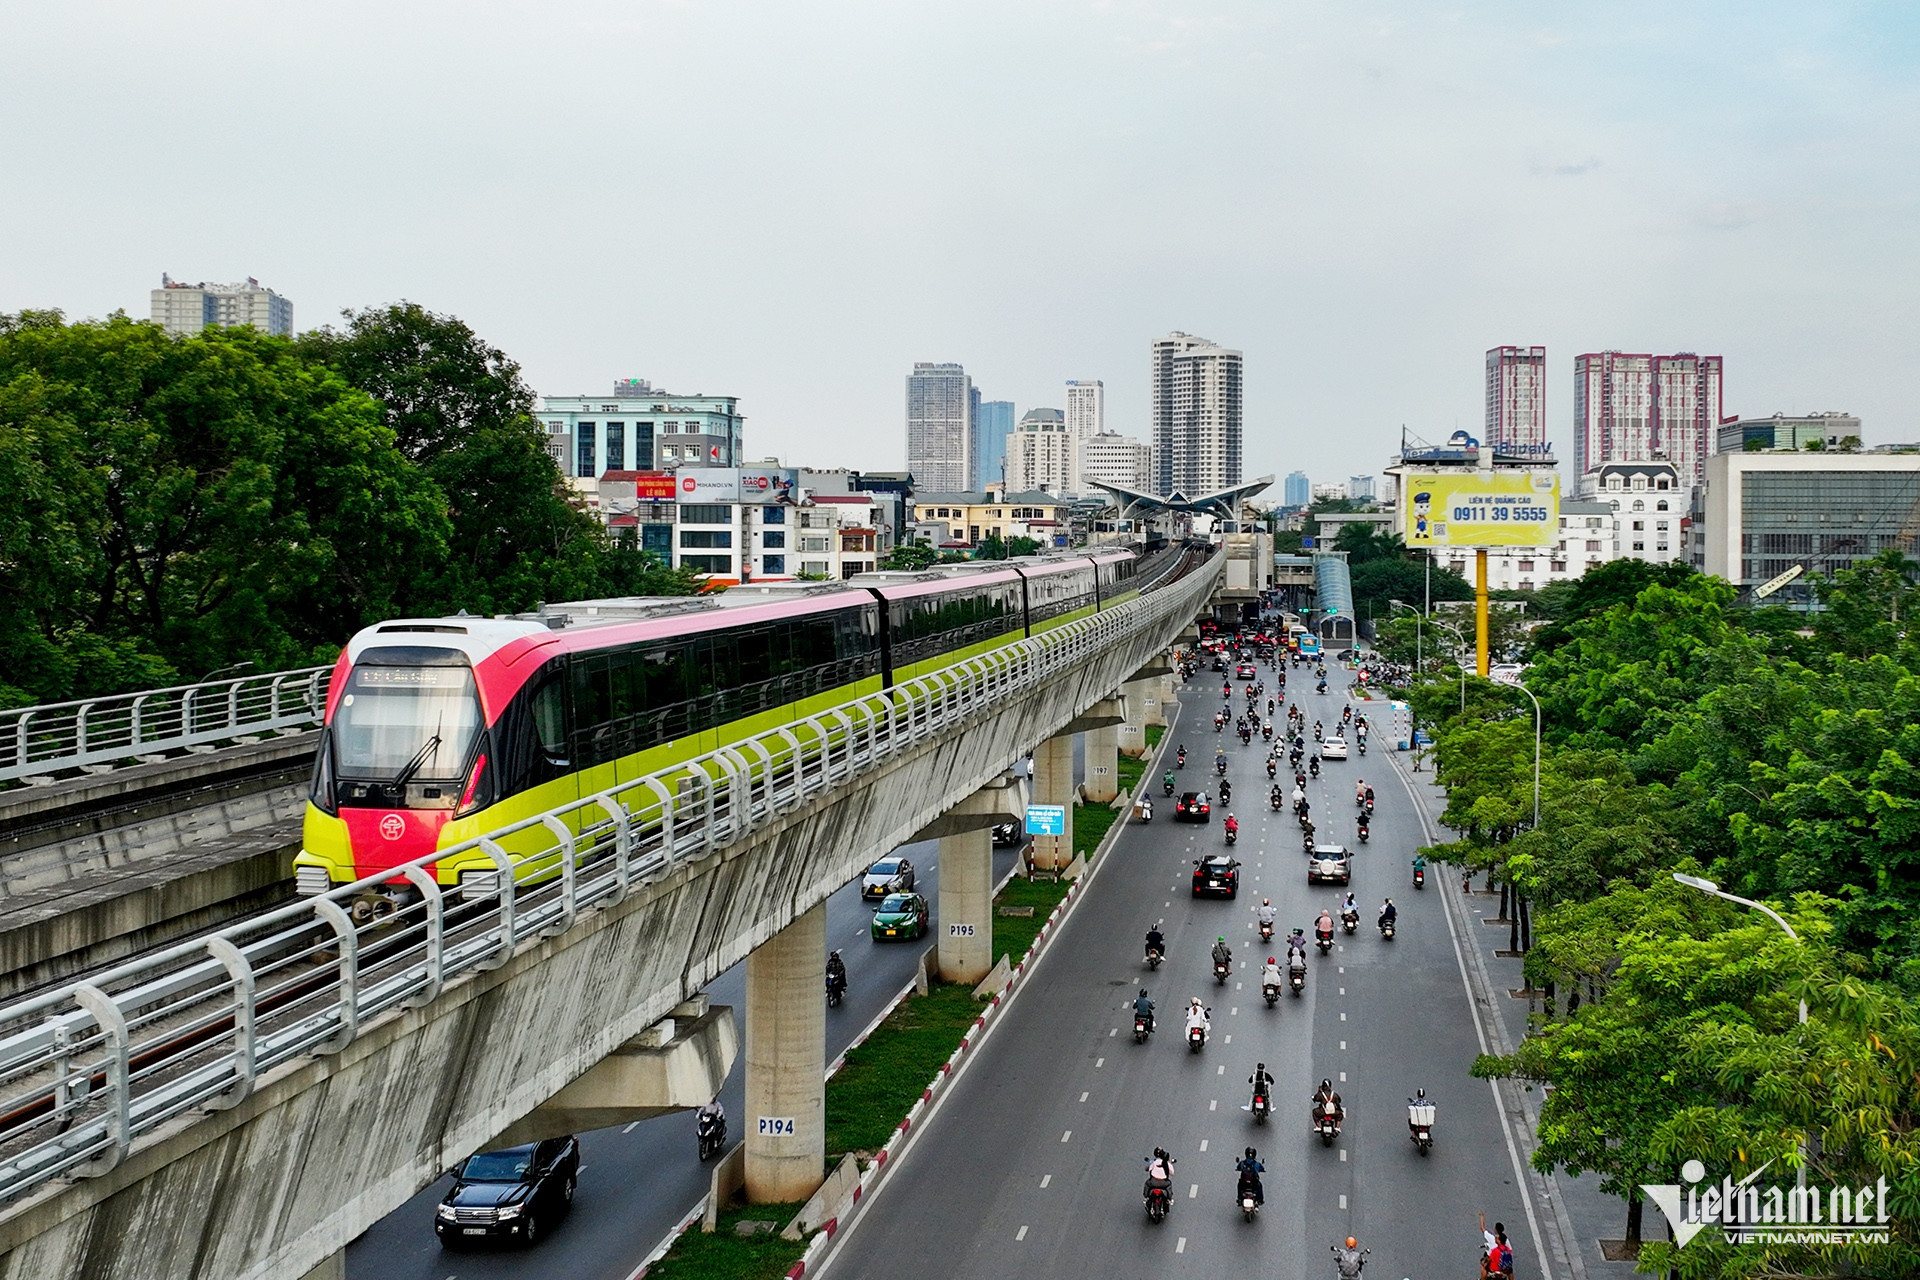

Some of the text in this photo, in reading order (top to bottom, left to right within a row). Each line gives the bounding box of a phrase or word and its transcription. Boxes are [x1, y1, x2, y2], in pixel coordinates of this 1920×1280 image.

[1469, 496, 1483, 504] LIÊN
[1453, 507, 1547, 521] 0911 39 5555
[951, 925, 974, 936] P195
[759, 1119, 794, 1134] P194
